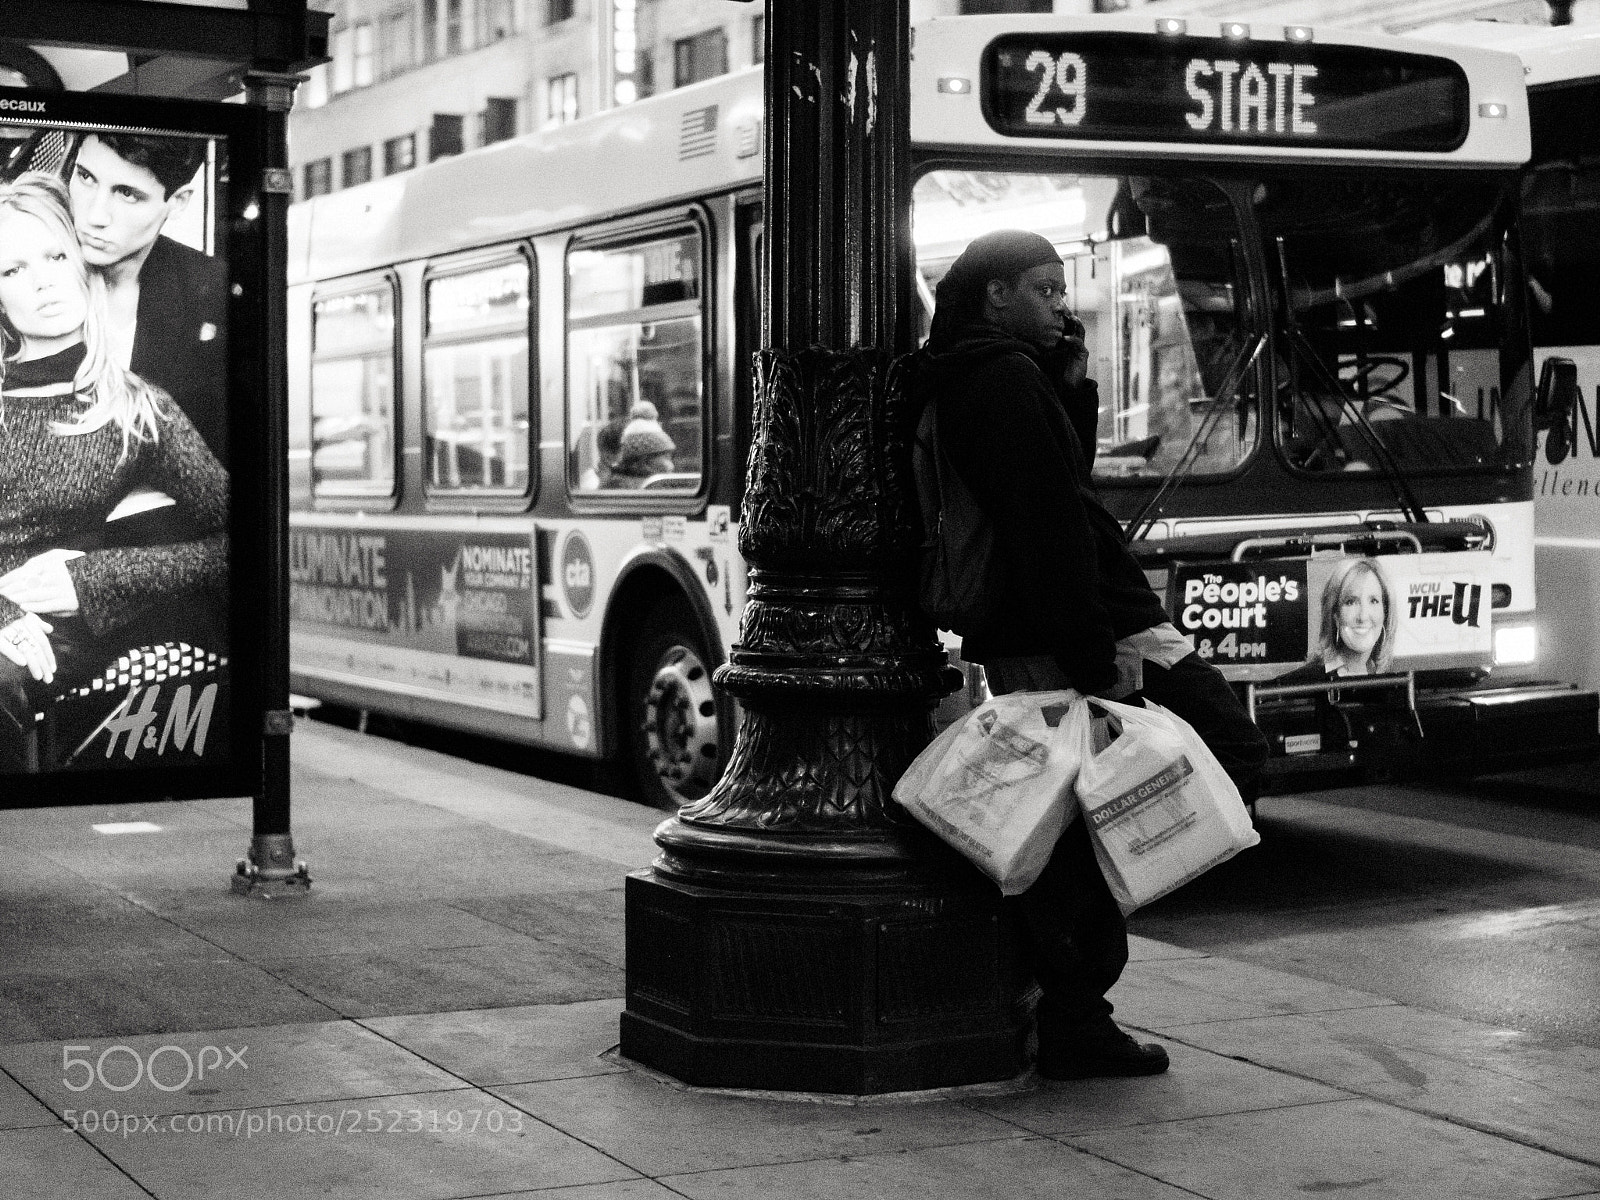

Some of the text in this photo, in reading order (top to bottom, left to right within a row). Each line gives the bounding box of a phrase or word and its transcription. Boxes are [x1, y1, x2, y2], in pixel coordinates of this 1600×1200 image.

[0, 98, 46, 112] ecaux
[1025, 50, 1318, 134] 29 STATE
[463, 545, 531, 574] NOMINATE
[566, 557, 590, 588] cta
[1184, 575, 1299, 607] People's
[1203, 573, 1223, 584] The
[1409, 582, 1441, 595] WCIU
[1182, 603, 1267, 629] Court
[1407, 594, 1453, 619] THE
[1198, 638, 1214, 658] &
[105, 683, 218, 760] H&M
[1092, 794, 1137, 824] DOLLAR
[1138, 761, 1188, 798] GENER
